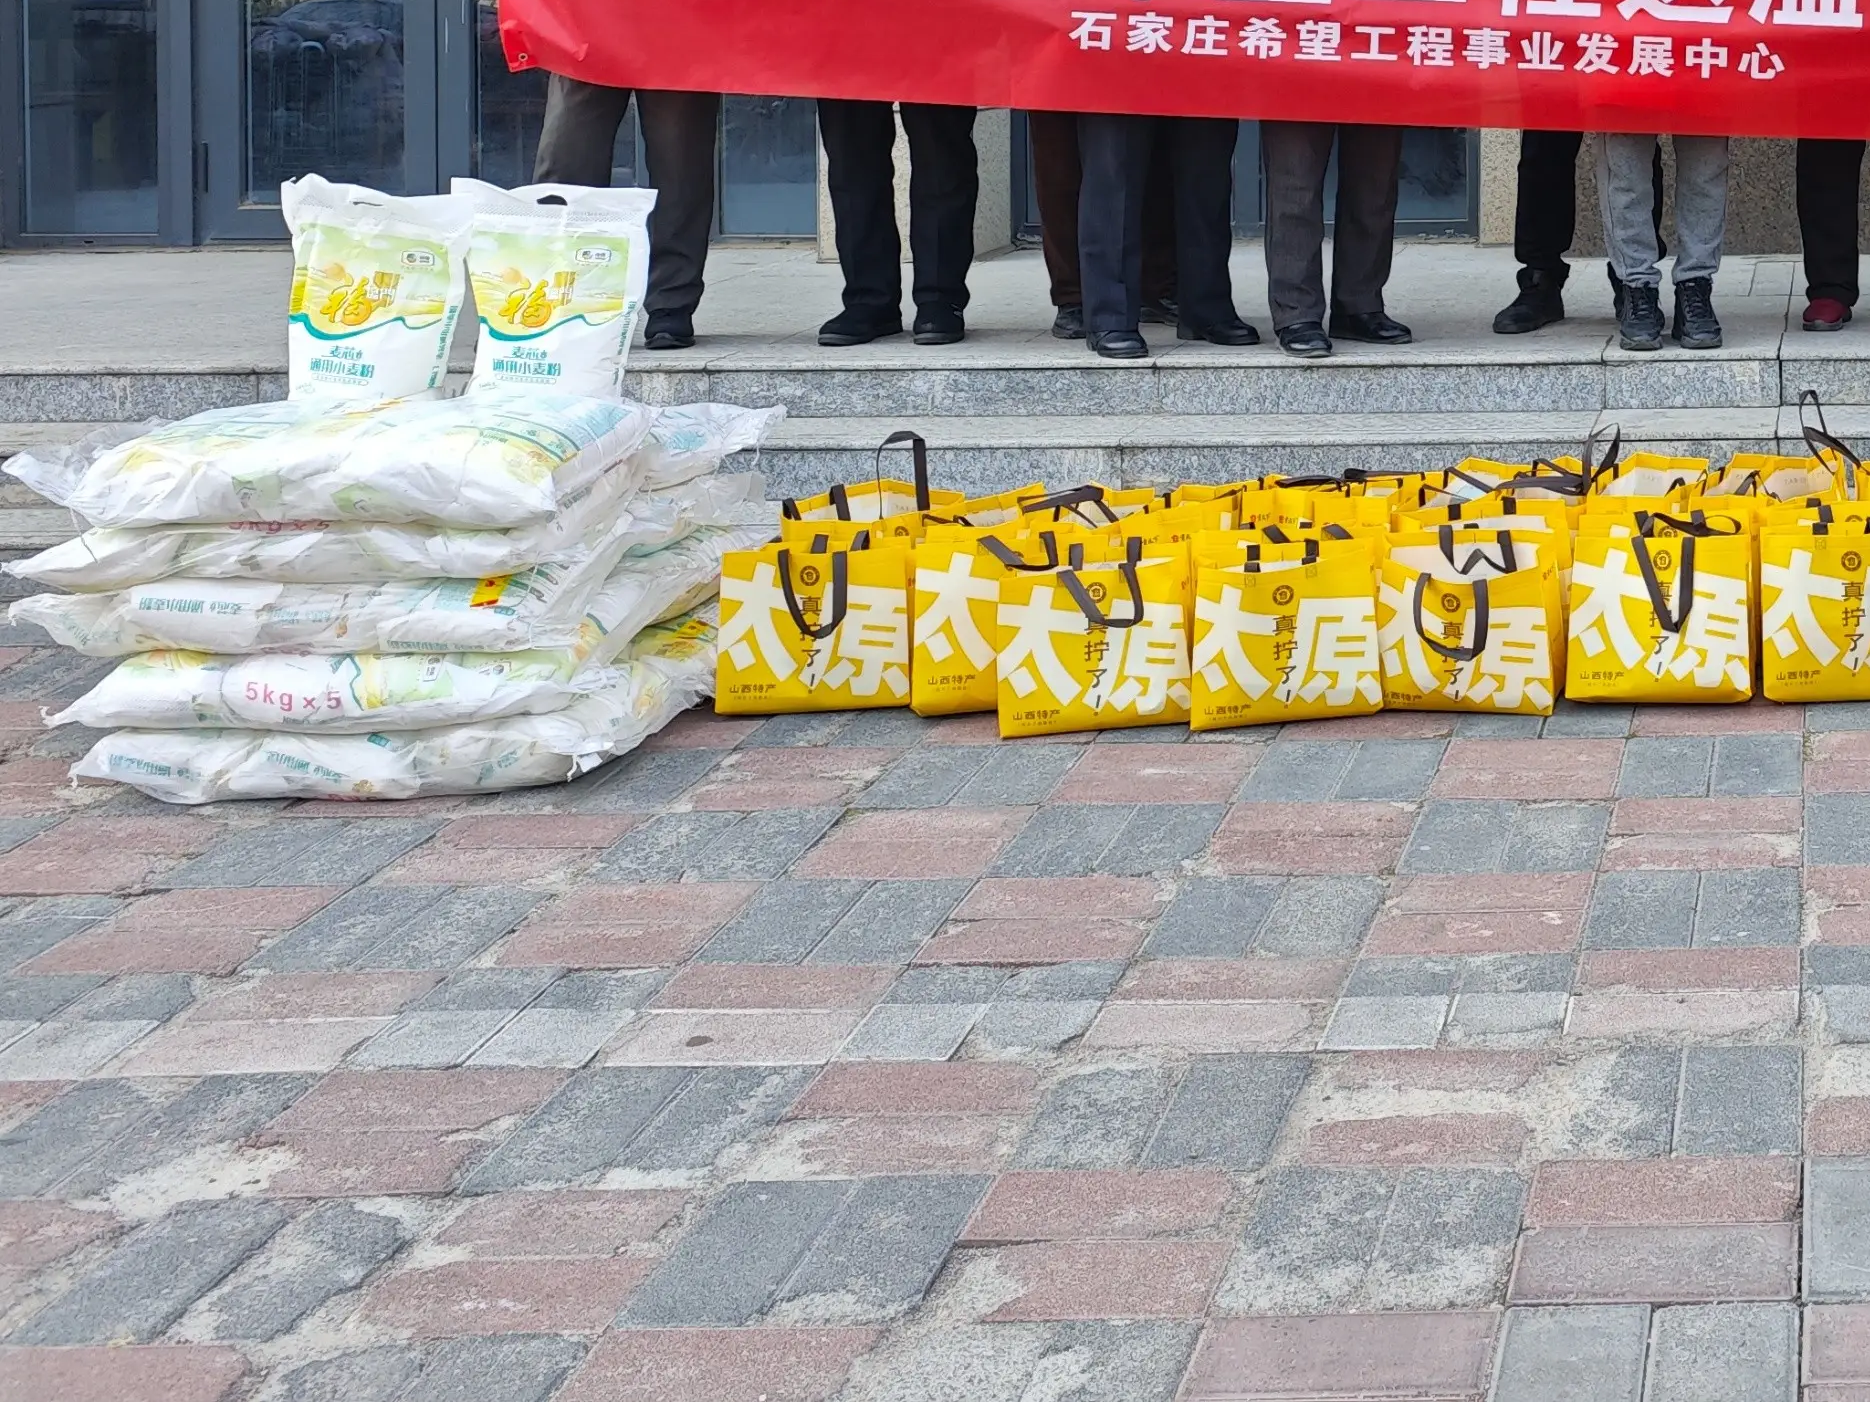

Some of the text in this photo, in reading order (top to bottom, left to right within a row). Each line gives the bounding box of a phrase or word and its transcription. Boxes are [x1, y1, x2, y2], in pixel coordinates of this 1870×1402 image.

[1069, 9, 1787, 81] 石家庄希望工程事业发展中心
[310, 358, 375, 378] 通用小麦粉
[493, 359, 561, 376] 通用小麦粉
[1568, 548, 1751, 691] 太原
[716, 562, 910, 698] 太原
[997, 582, 1191, 715] 太原
[1193, 584, 1383, 708] 太原
[1380, 577, 1553, 710] 太原
[927, 674, 976, 687] 山西特产
[1580, 671, 1625, 683] 山西特产
[1776, 669, 1822, 682] 山西特产
[729, 683, 777, 694] 山西特产
[1012, 709, 1060, 722] 山西特产
[1203, 703, 1252, 716] 山西特产
